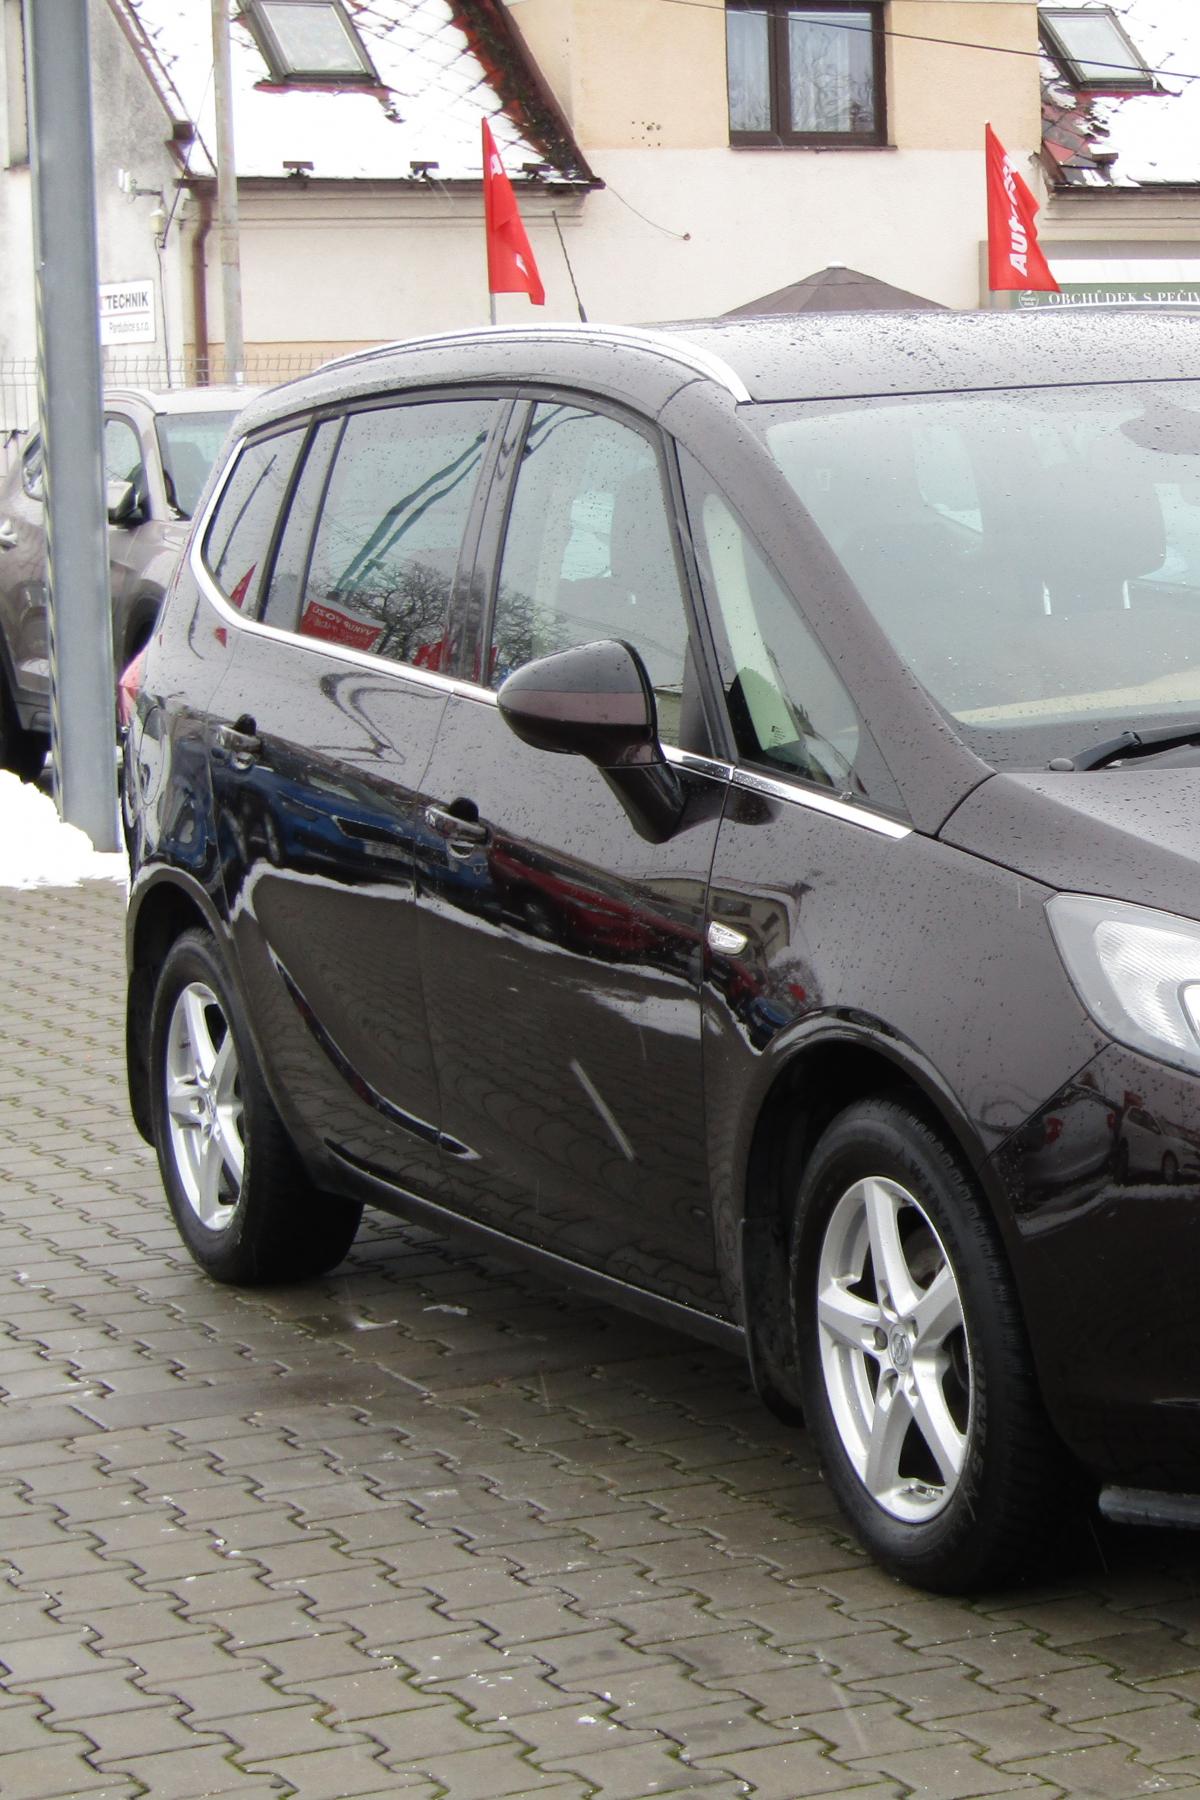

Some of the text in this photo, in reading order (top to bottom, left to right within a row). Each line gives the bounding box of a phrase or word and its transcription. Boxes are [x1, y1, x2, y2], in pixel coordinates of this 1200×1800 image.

[105, 291, 149, 310] TECHNIK
[1048, 289, 1138, 306] OBCHŮDEK
[1143, 292, 1152, 304] S
